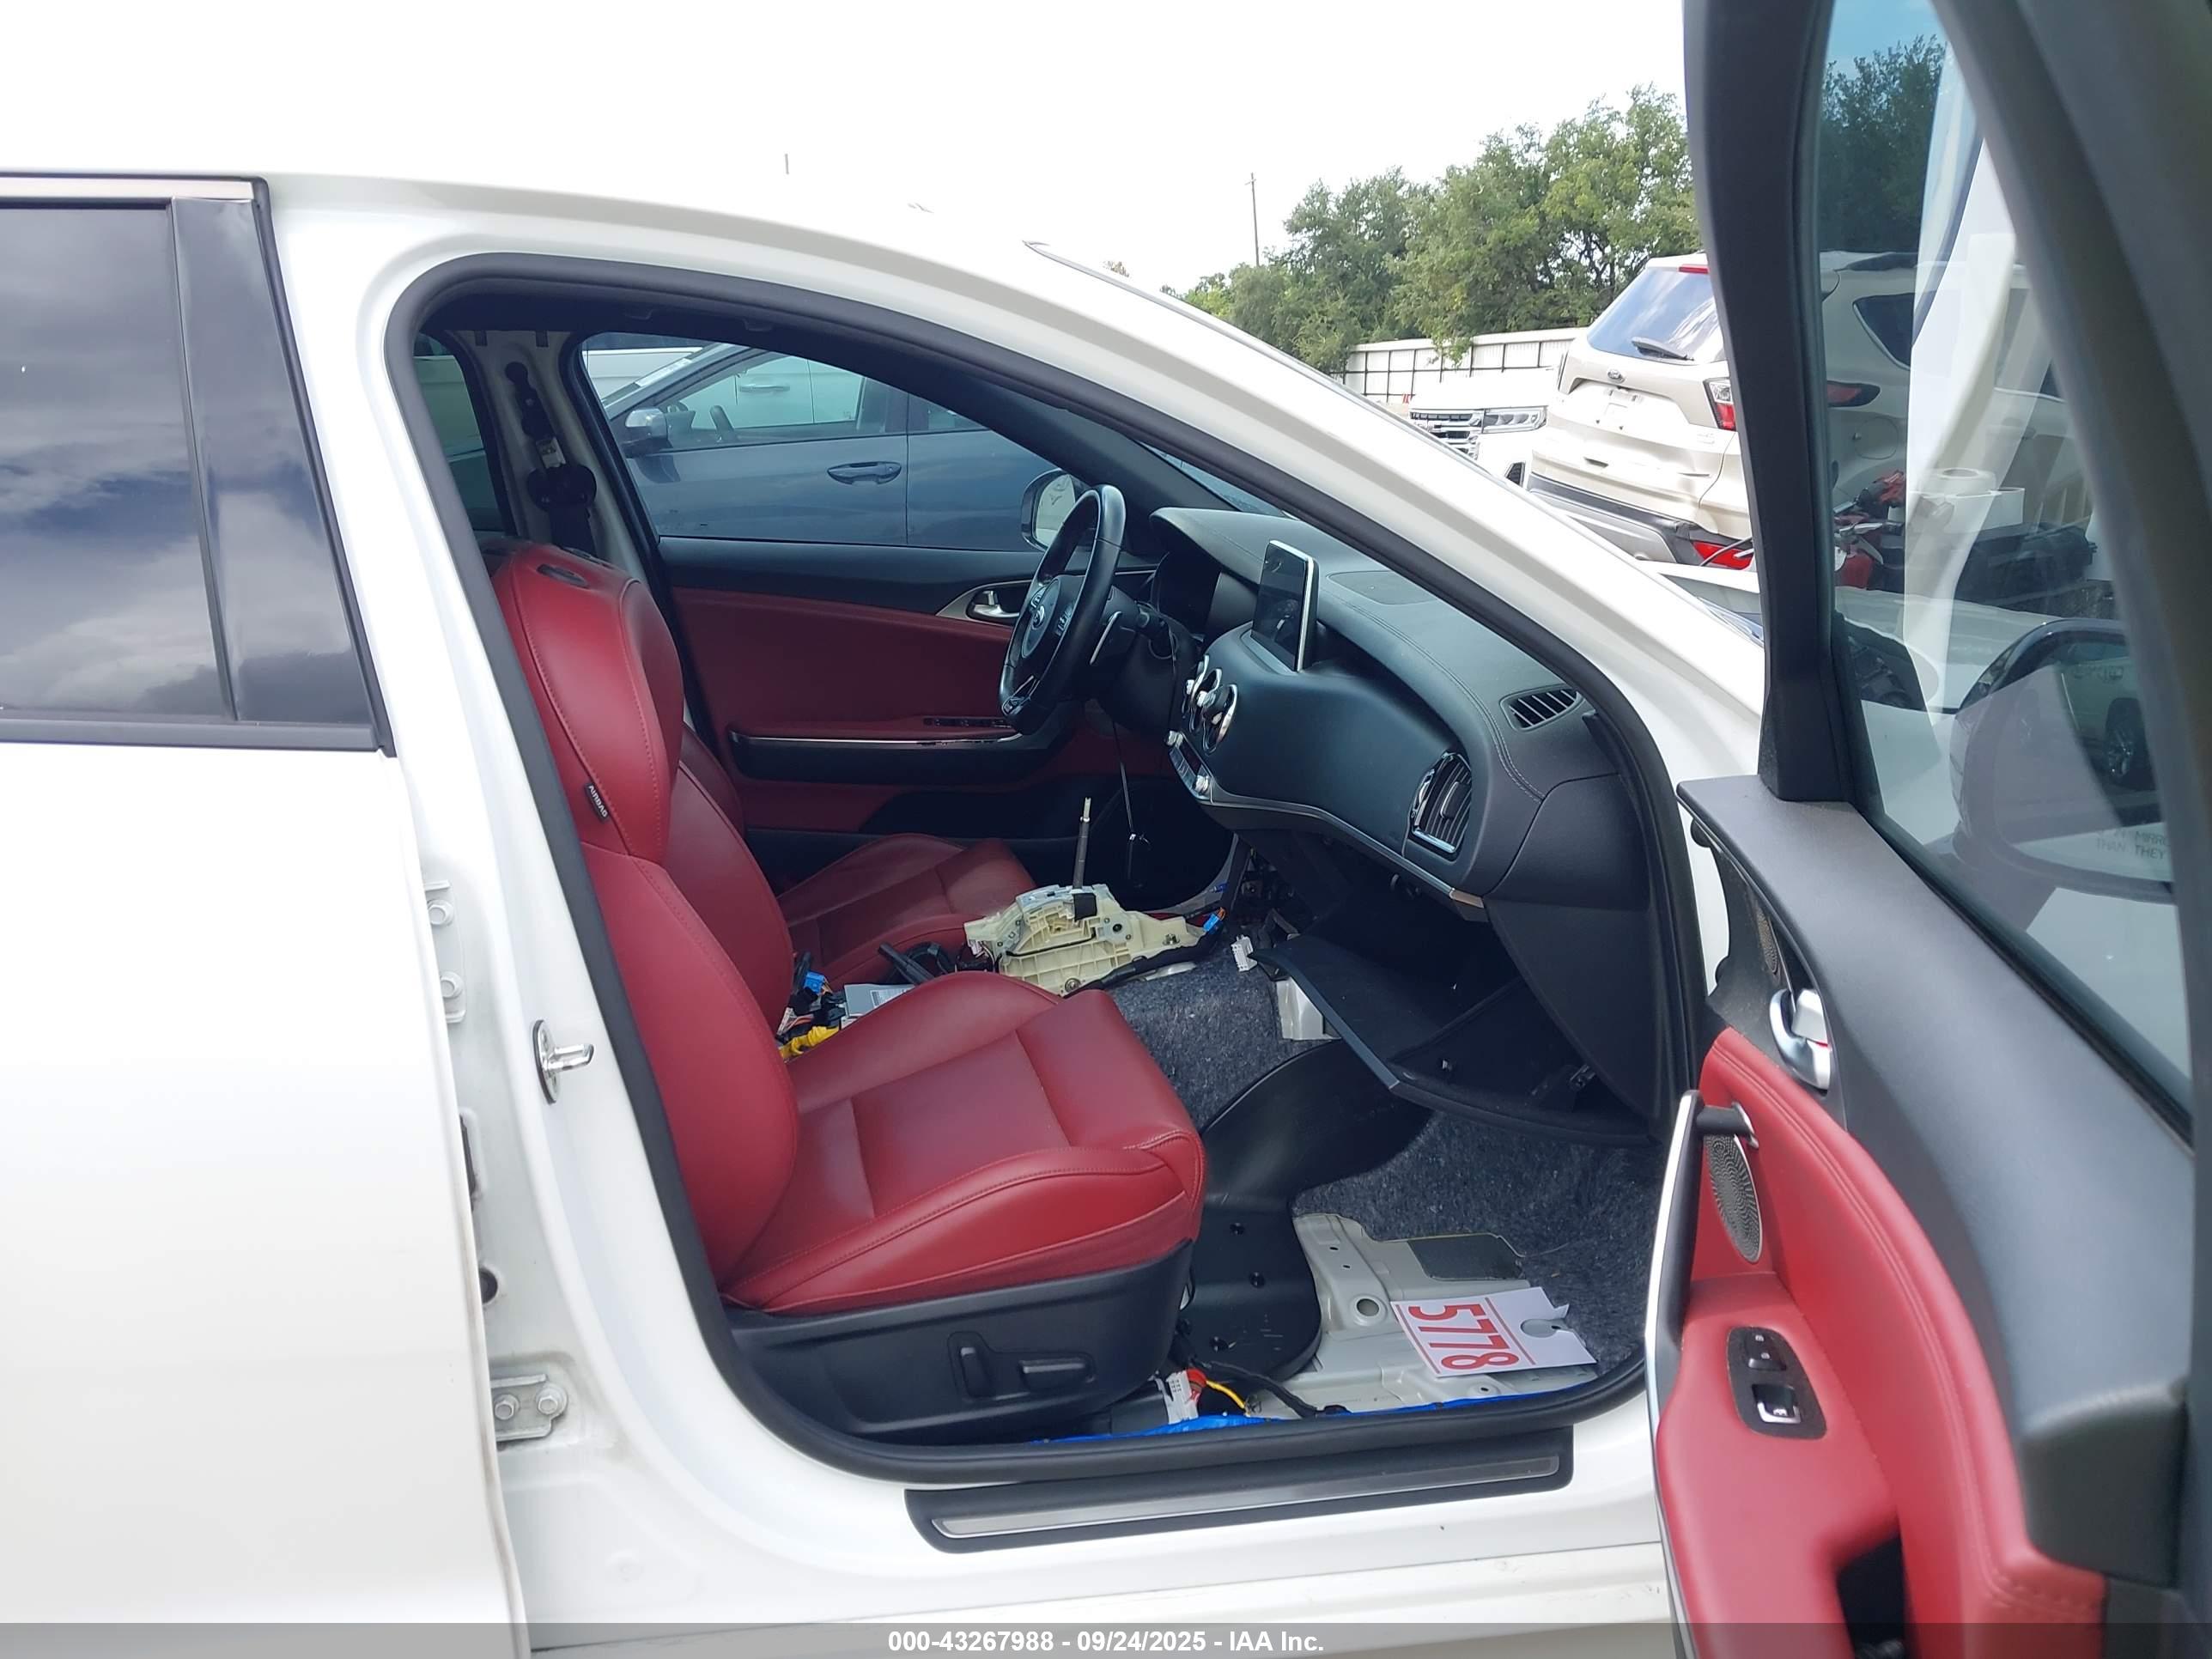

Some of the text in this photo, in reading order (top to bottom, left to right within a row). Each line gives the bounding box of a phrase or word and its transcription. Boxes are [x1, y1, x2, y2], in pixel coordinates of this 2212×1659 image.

[588, 785, 609, 817] AIRBAG
[2136, 844, 2166, 860] THEY
[1409, 1304, 1517, 1370] 5778
